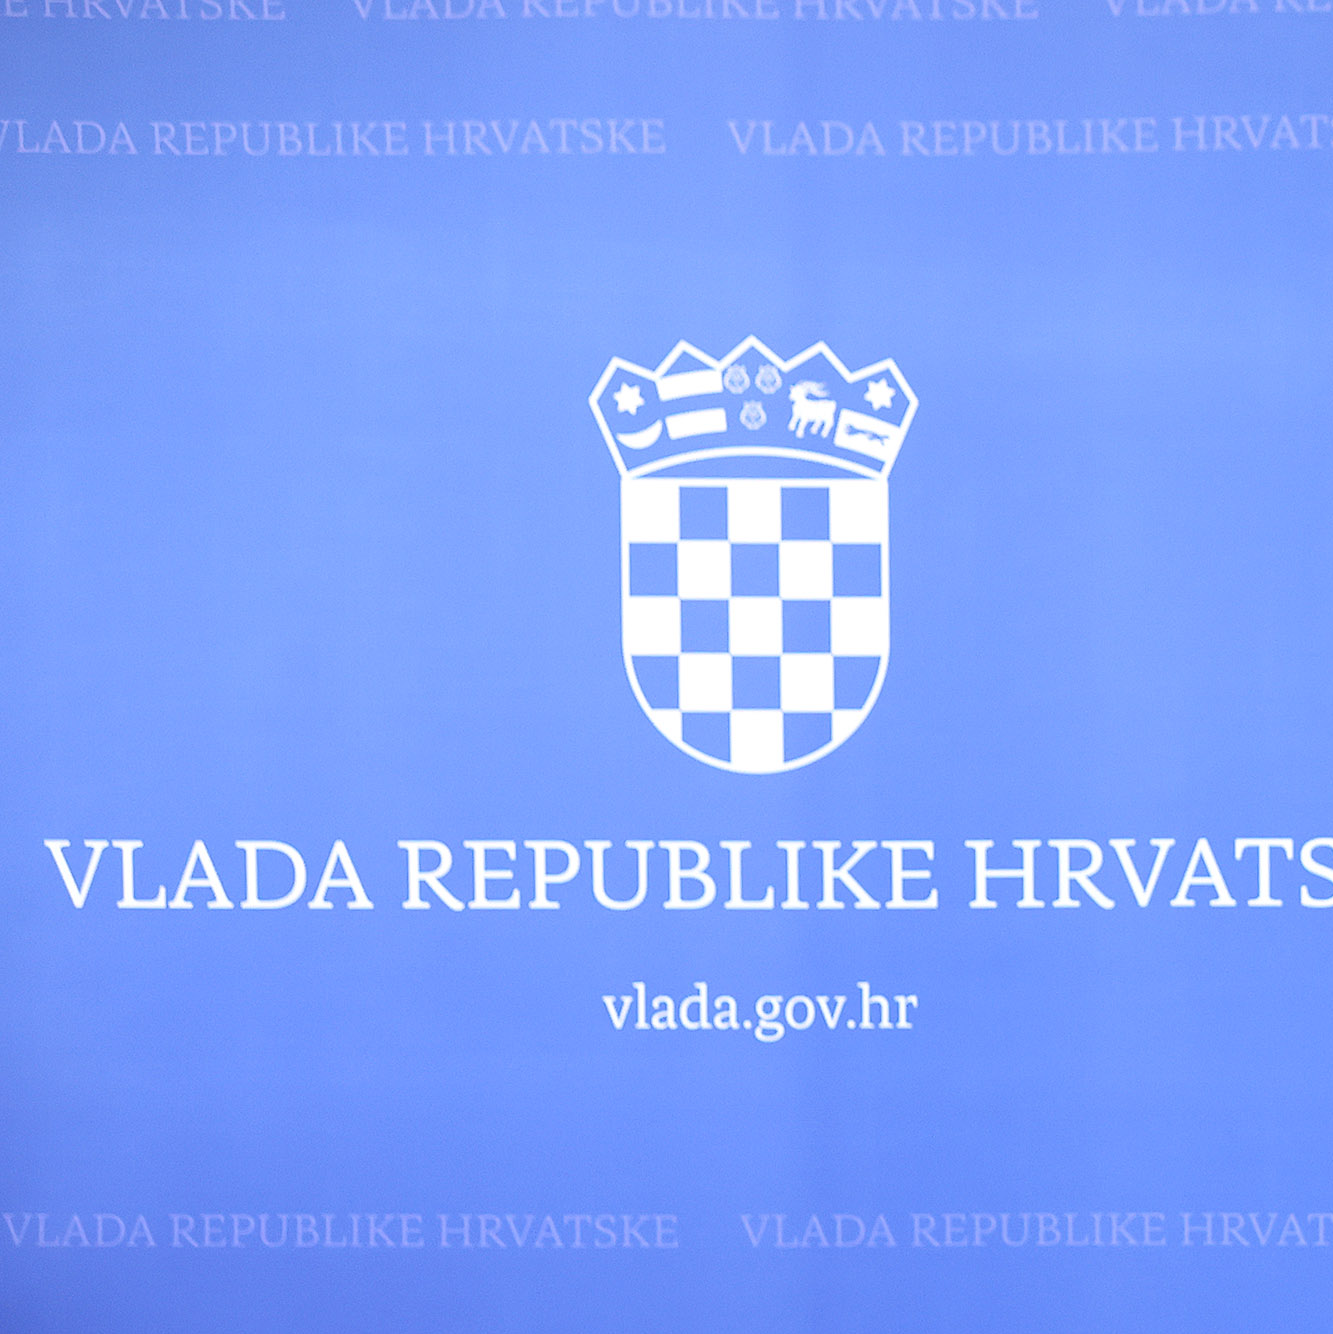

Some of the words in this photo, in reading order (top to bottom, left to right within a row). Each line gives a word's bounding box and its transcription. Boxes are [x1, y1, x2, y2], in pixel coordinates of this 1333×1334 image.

[149, 120, 409, 156] REPUBLIKE
[420, 118, 667, 156] HRVATSKE
[725, 119, 888, 157] VLADA
[897, 117, 1160, 157] REPUBLIKE
[43, 839, 374, 910] VLADA
[397, 839, 938, 911] REPUBLIKE
[602, 981, 918, 1043] vlada.gov.hr
[2, 1213, 157, 1248] VLADA
[168, 1213, 425, 1249] REPUBLIKE
[436, 1213, 680, 1249] HRVATSKE
[739, 1213, 898, 1249] VLADA
[909, 1212, 1167, 1248] REPUBLIKE
